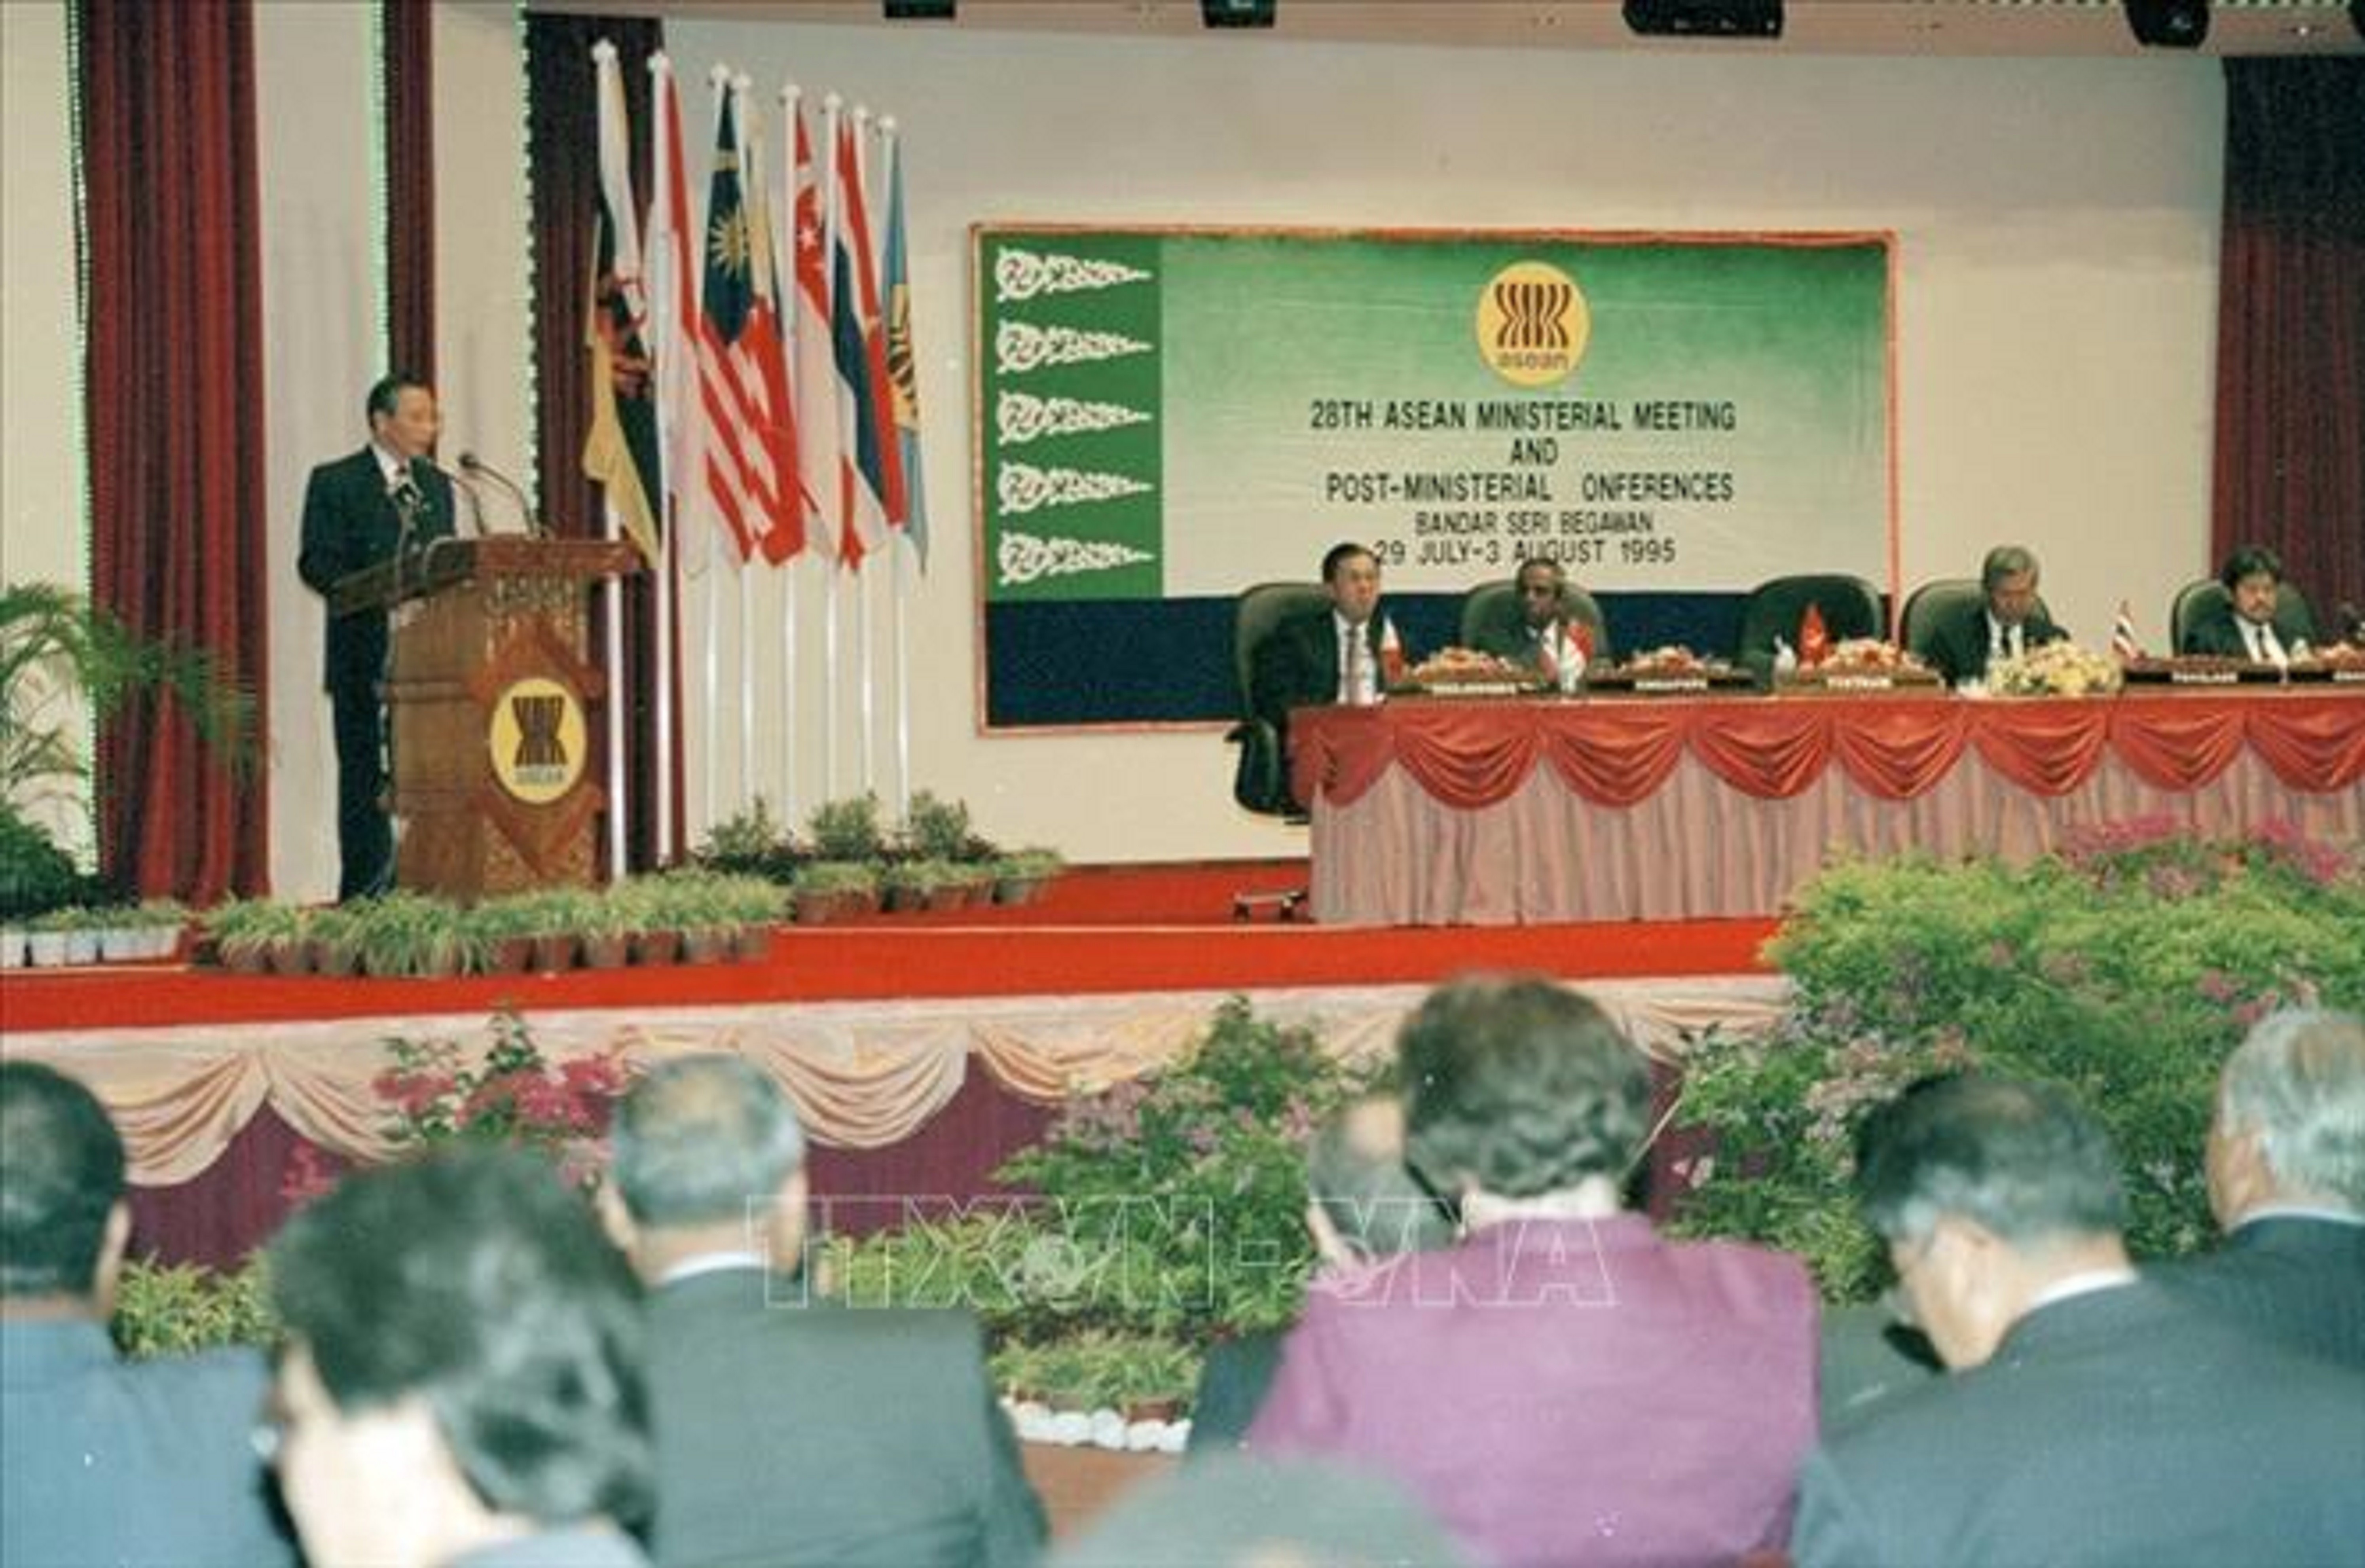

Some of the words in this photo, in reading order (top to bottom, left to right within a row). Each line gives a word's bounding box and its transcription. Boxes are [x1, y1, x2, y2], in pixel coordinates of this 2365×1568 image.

[1311, 400, 1373, 429] 28TH
[1384, 400, 1466, 430] ASEAN
[1477, 400, 1622, 430] MINISTERIAL
[1633, 400, 1736, 430] MEETING
[1510, 437, 1558, 466] AND
[1326, 473, 1552, 502] POST-MINISTERIAL
[1583, 472, 1733, 502] ONFERENCES
[1415, 511, 1497, 535] BANDAR
[1506, 511, 1551, 535] SERI
[1561, 511, 1654, 534] BEGAWAN
[1373, 539, 1405, 565] 29
[1513, 539, 1606, 563] AUGUST
[1622, 539, 1676, 563] 1995
